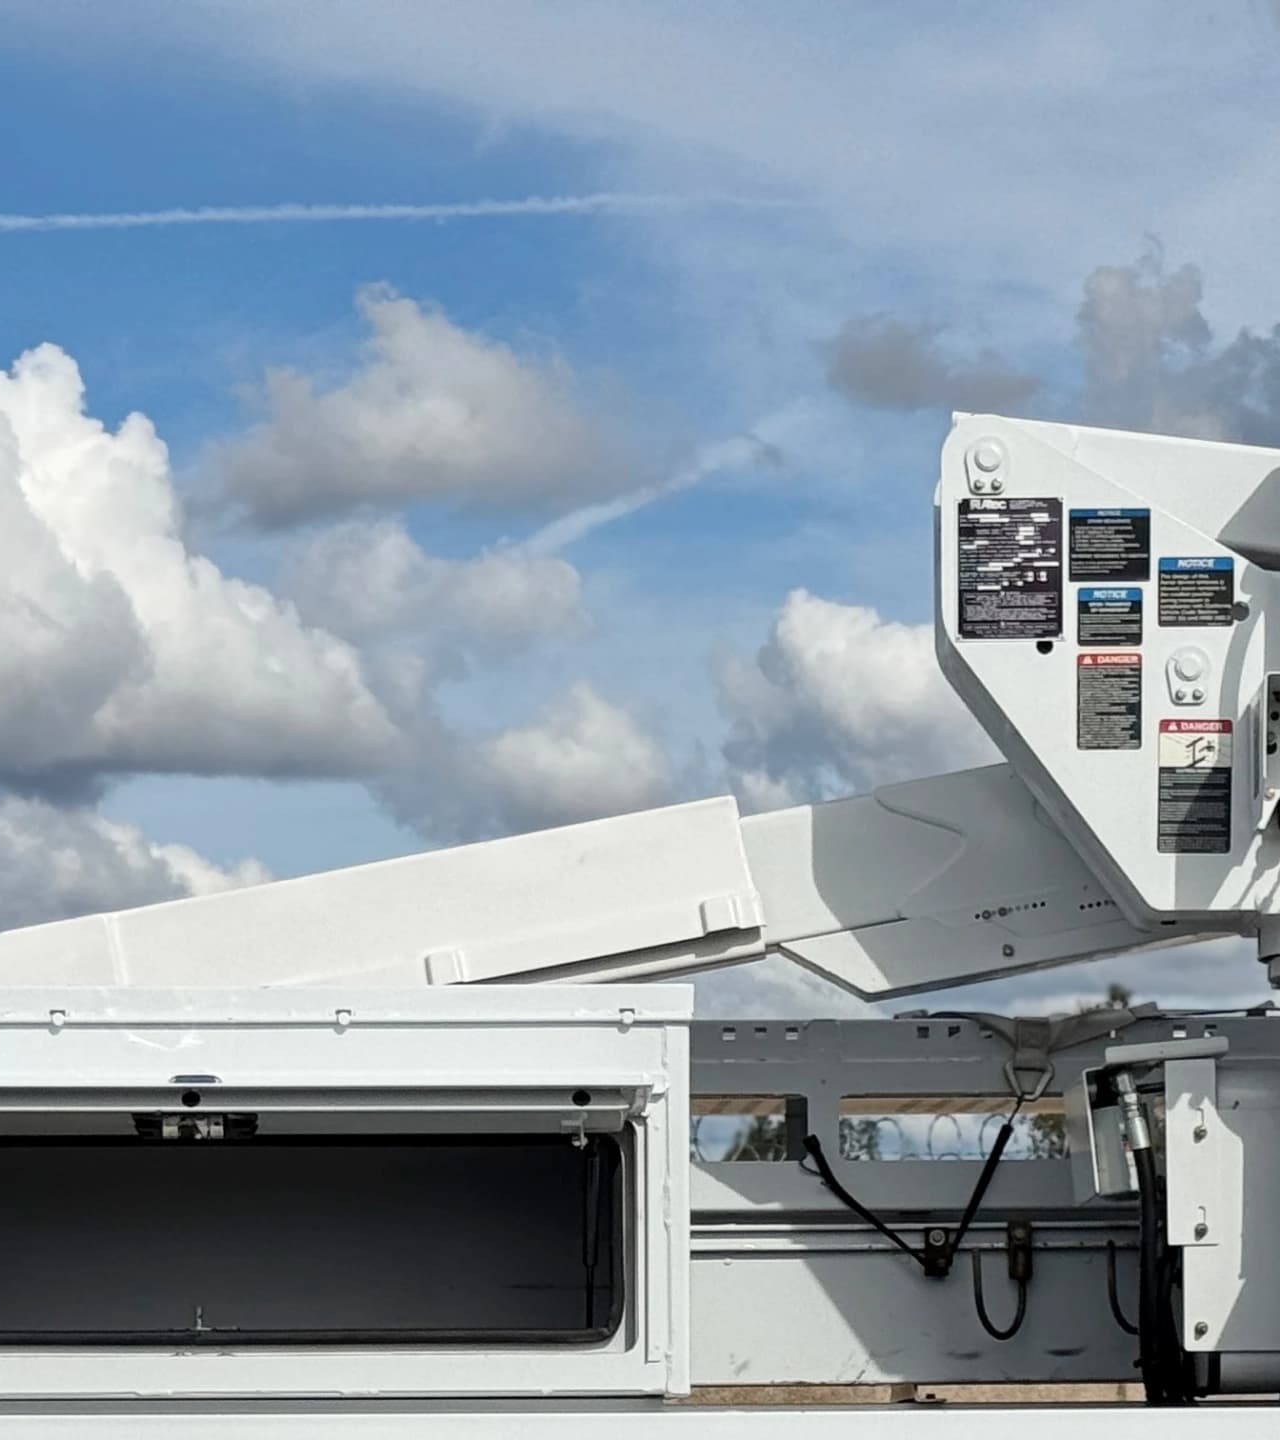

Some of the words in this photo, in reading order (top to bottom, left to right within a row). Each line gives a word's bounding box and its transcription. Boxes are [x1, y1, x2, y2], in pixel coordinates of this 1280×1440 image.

[1177, 559, 1216, 569] NOTICE
[1093, 590, 1128, 599] NOTICE
[1097, 655, 1139, 664] DANGER
[1181, 722, 1223, 731] DANGER
